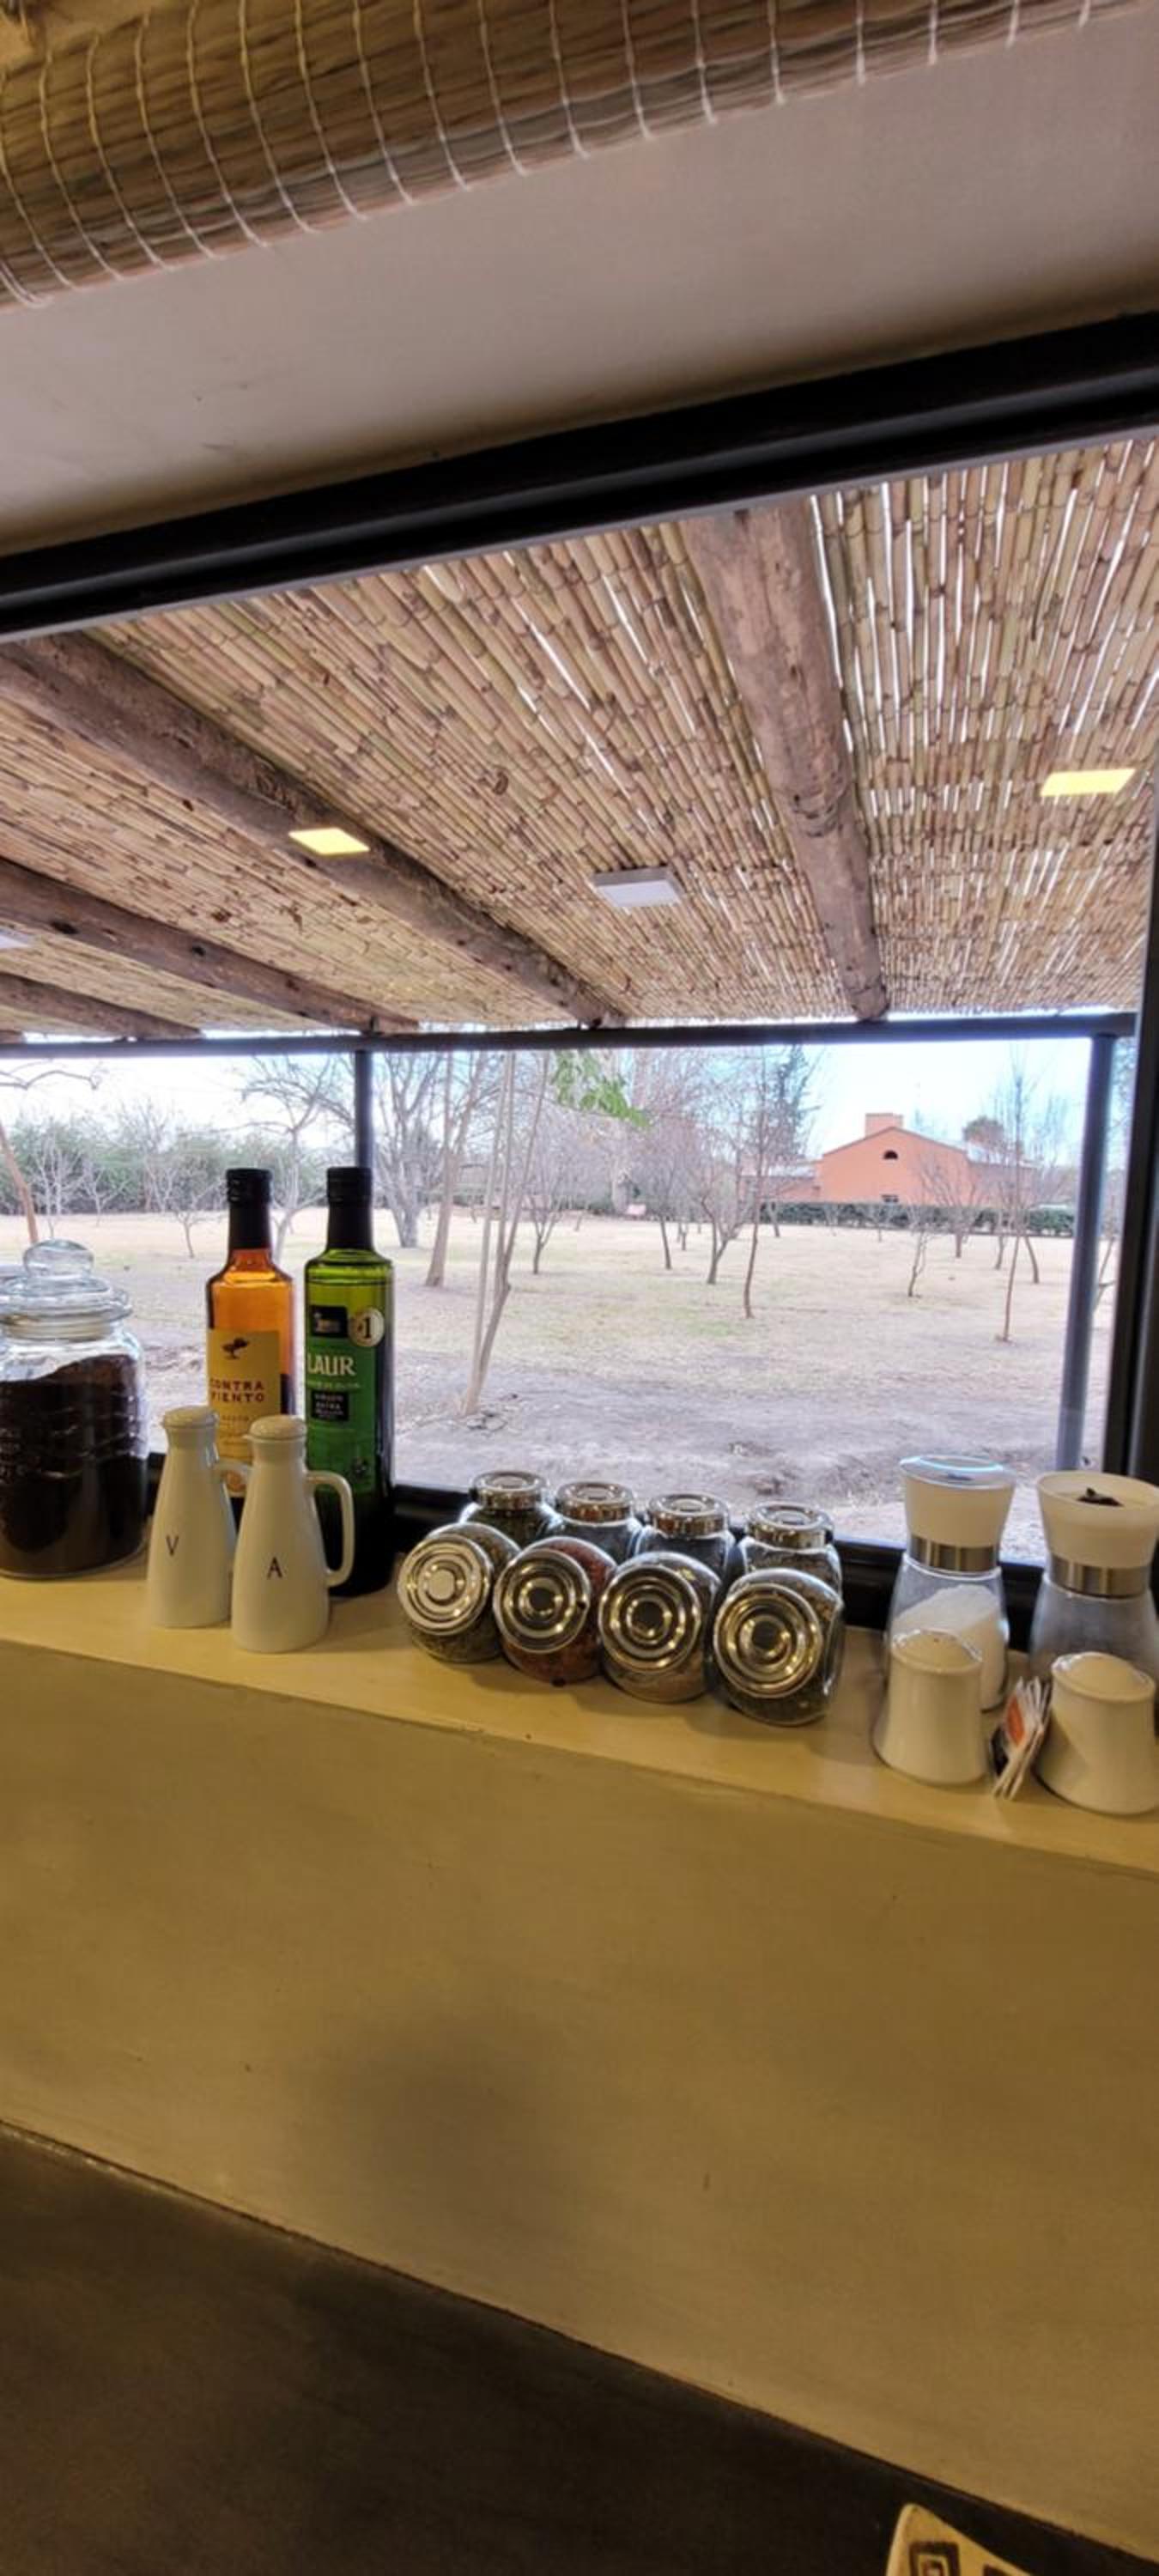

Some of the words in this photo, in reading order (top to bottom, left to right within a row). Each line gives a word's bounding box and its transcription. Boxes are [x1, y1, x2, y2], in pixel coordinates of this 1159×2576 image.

[307, 1353, 356, 1376] LAUR
[165, 1534, 179, 1556] V
[266, 1556, 283, 1578] A
